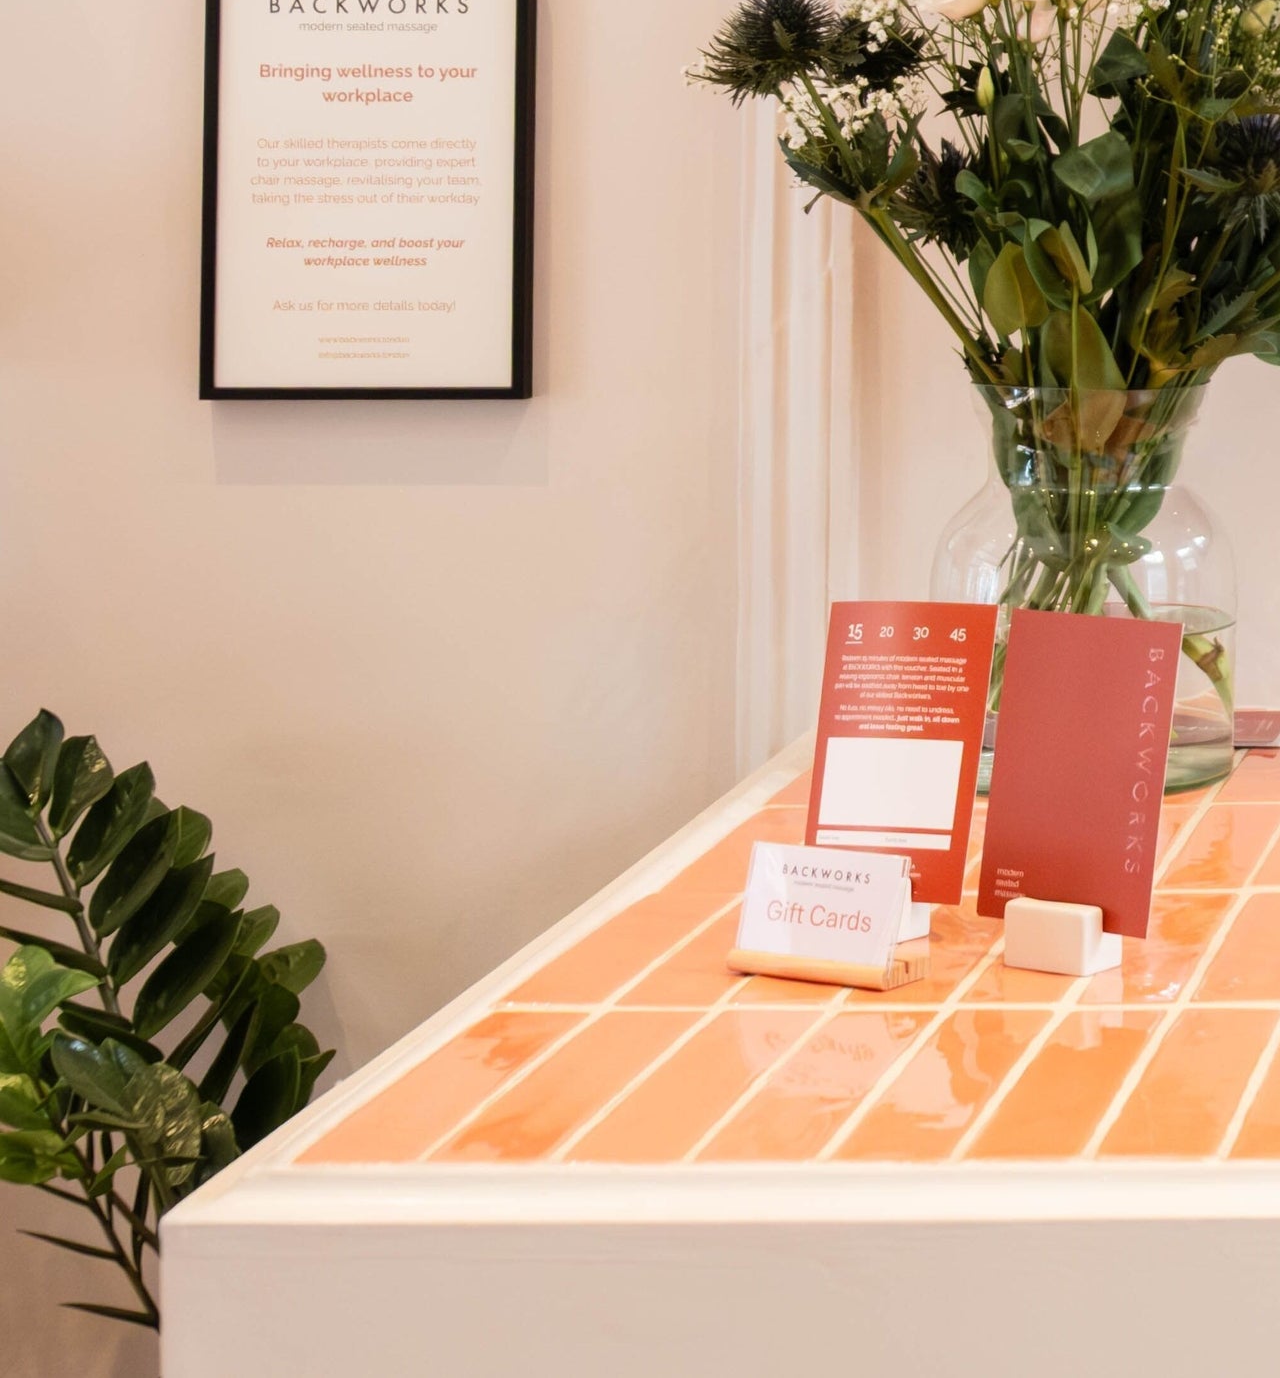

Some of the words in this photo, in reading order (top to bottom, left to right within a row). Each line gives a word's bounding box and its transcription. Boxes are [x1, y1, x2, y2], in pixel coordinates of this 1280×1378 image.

[260, 64, 331, 81] Bringing
[337, 64, 412, 77] wellness
[418, 65, 434, 77] to
[439, 67, 476, 81] your
[322, 88, 413, 104] workplace
[371, 237, 395, 249] and
[399, 237, 434, 249] boost
[435, 239, 465, 251] your
[303, 255, 370, 268] workplace
[373, 255, 427, 267] wellness
[848, 623, 864, 641] 15
[879, 626, 895, 638] 20
[912, 626, 930, 641] 30
[949, 628, 967, 642] 45
[782, 864, 871, 884] BACKWORKS
[767, 900, 805, 926] Gift
[810, 905, 872, 933] Cards
